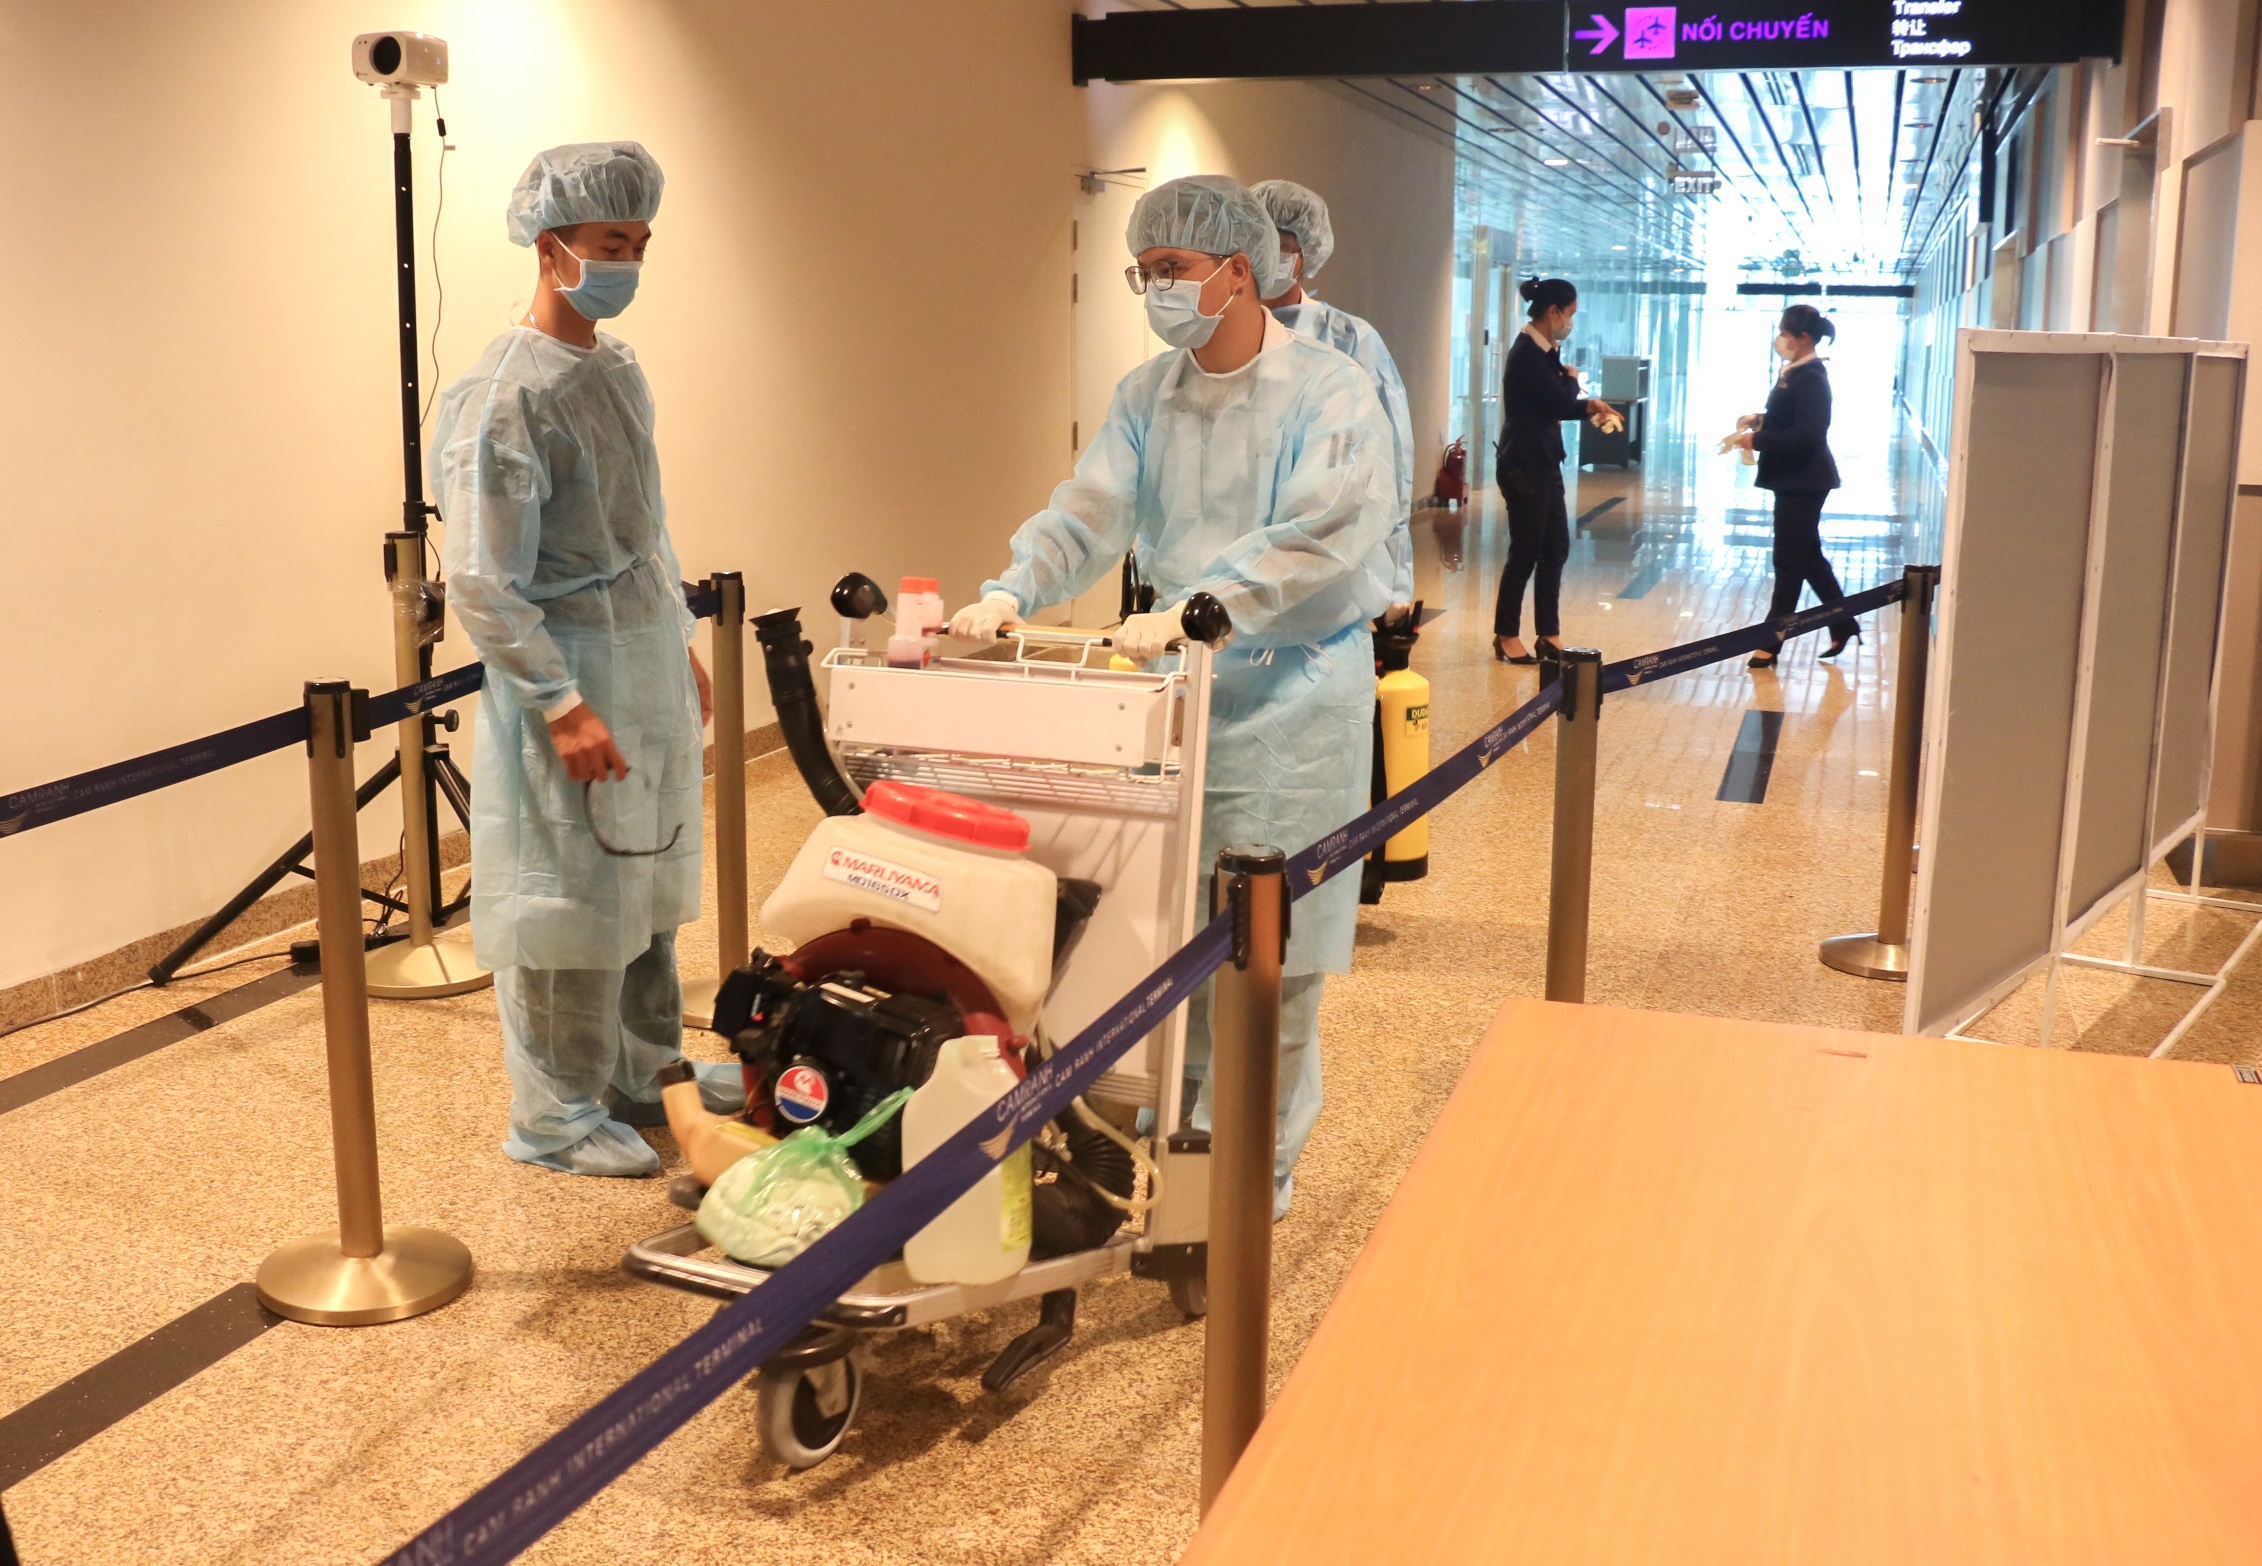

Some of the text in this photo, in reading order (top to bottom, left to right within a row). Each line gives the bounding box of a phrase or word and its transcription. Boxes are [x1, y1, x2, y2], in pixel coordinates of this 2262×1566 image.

[1681, 12, 1829, 42] NỐI CHUYẾN
[1674, 176, 1713, 193] EXIT
[843, 856, 940, 896] MARUYAMA
